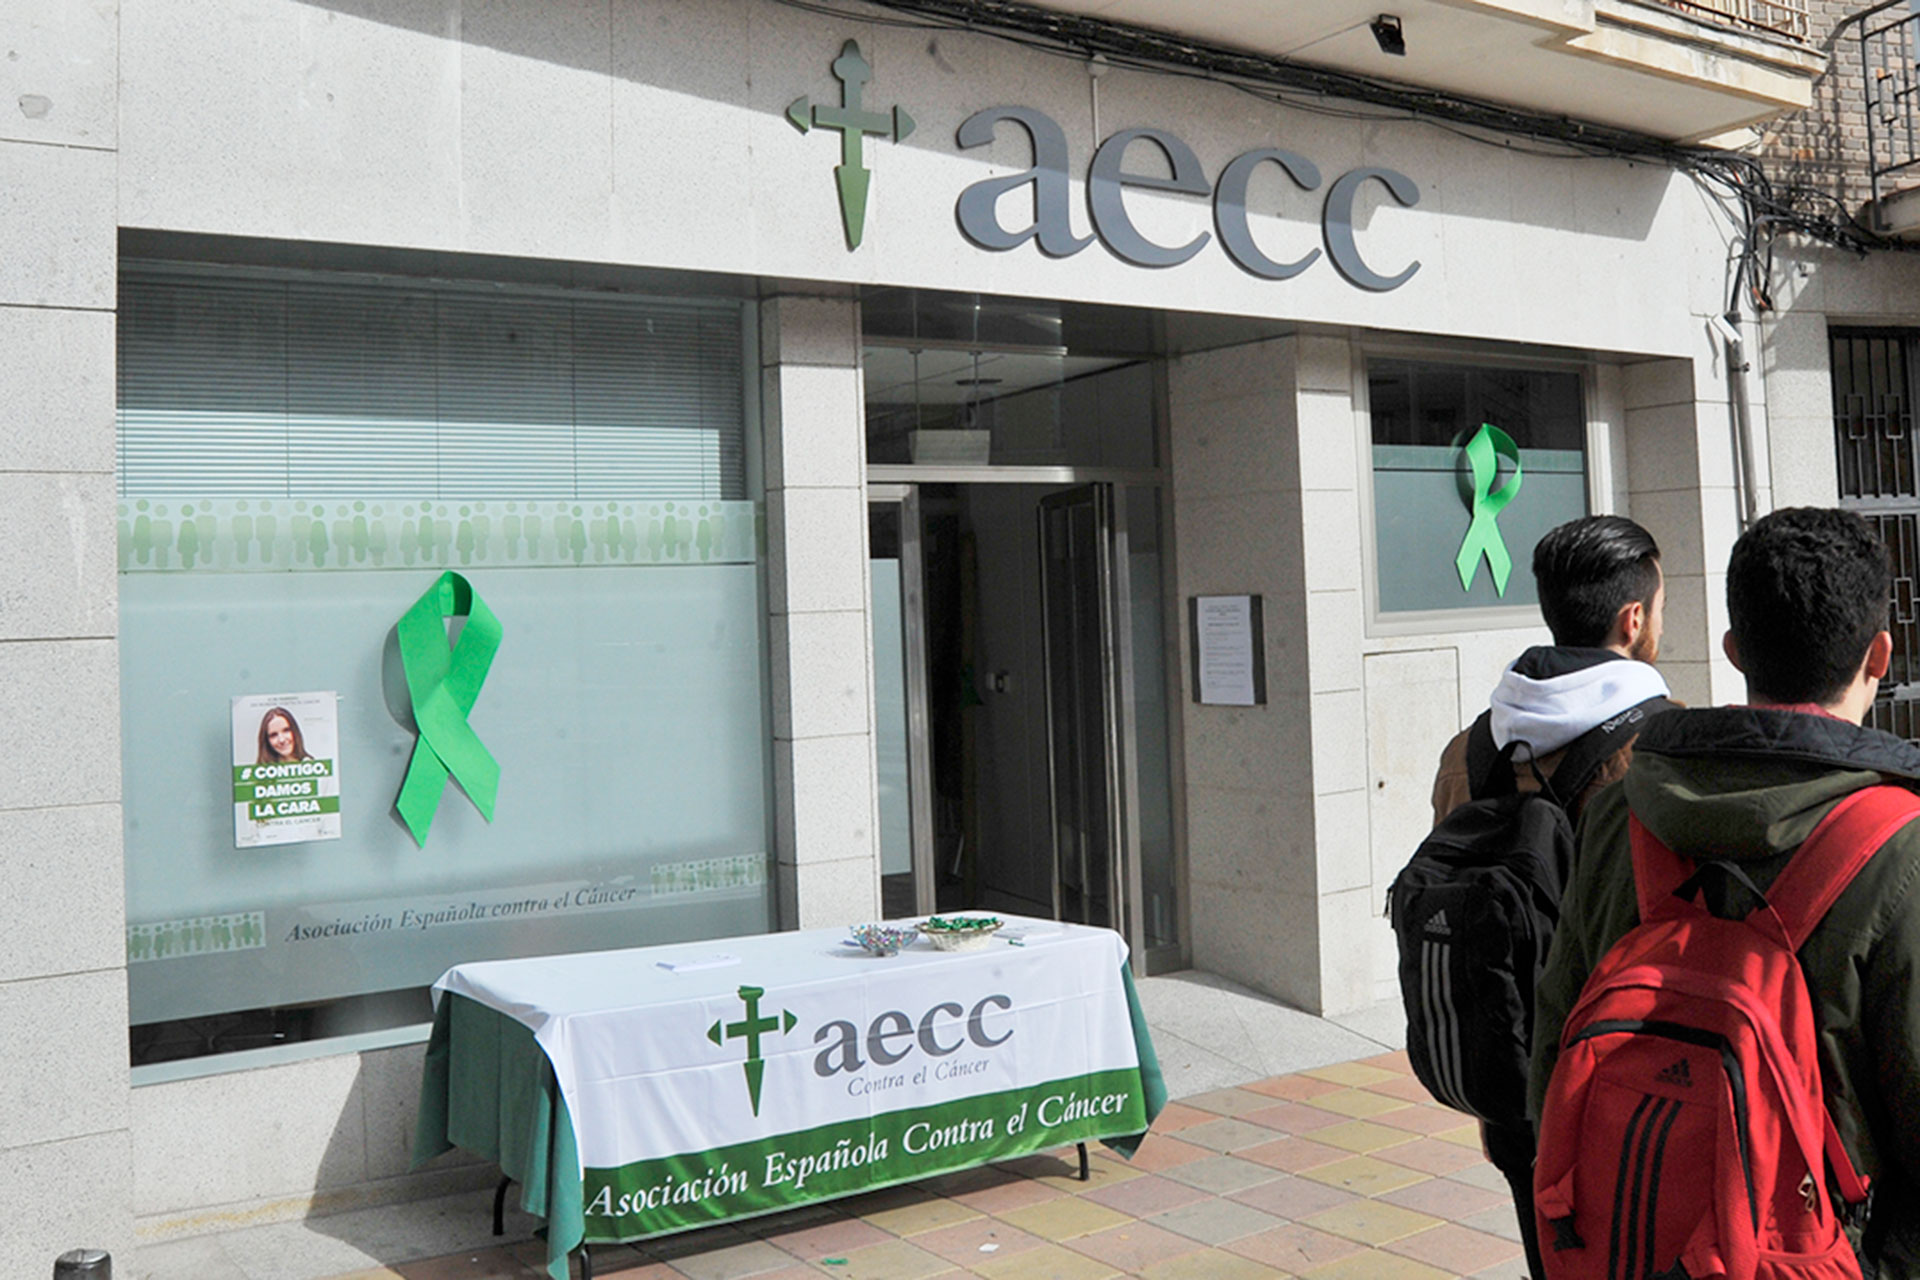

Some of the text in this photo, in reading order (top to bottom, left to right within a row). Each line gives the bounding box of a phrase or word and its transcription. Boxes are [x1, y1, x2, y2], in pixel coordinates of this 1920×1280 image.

[955, 104, 1421, 293] aecc
[254, 762, 328, 779] CONTIGO,
[255, 782, 312, 798] DAMOS
[255, 800, 321, 817] LA CARA
[285, 887, 636, 942] Asociación Española contra el Cáncer
[813, 994, 1014, 1078] aecc
[847, 1057, 989, 1097] Contra el Cáncer
[585, 1092, 1129, 1217] Asociación Española Contra el Cáncer
